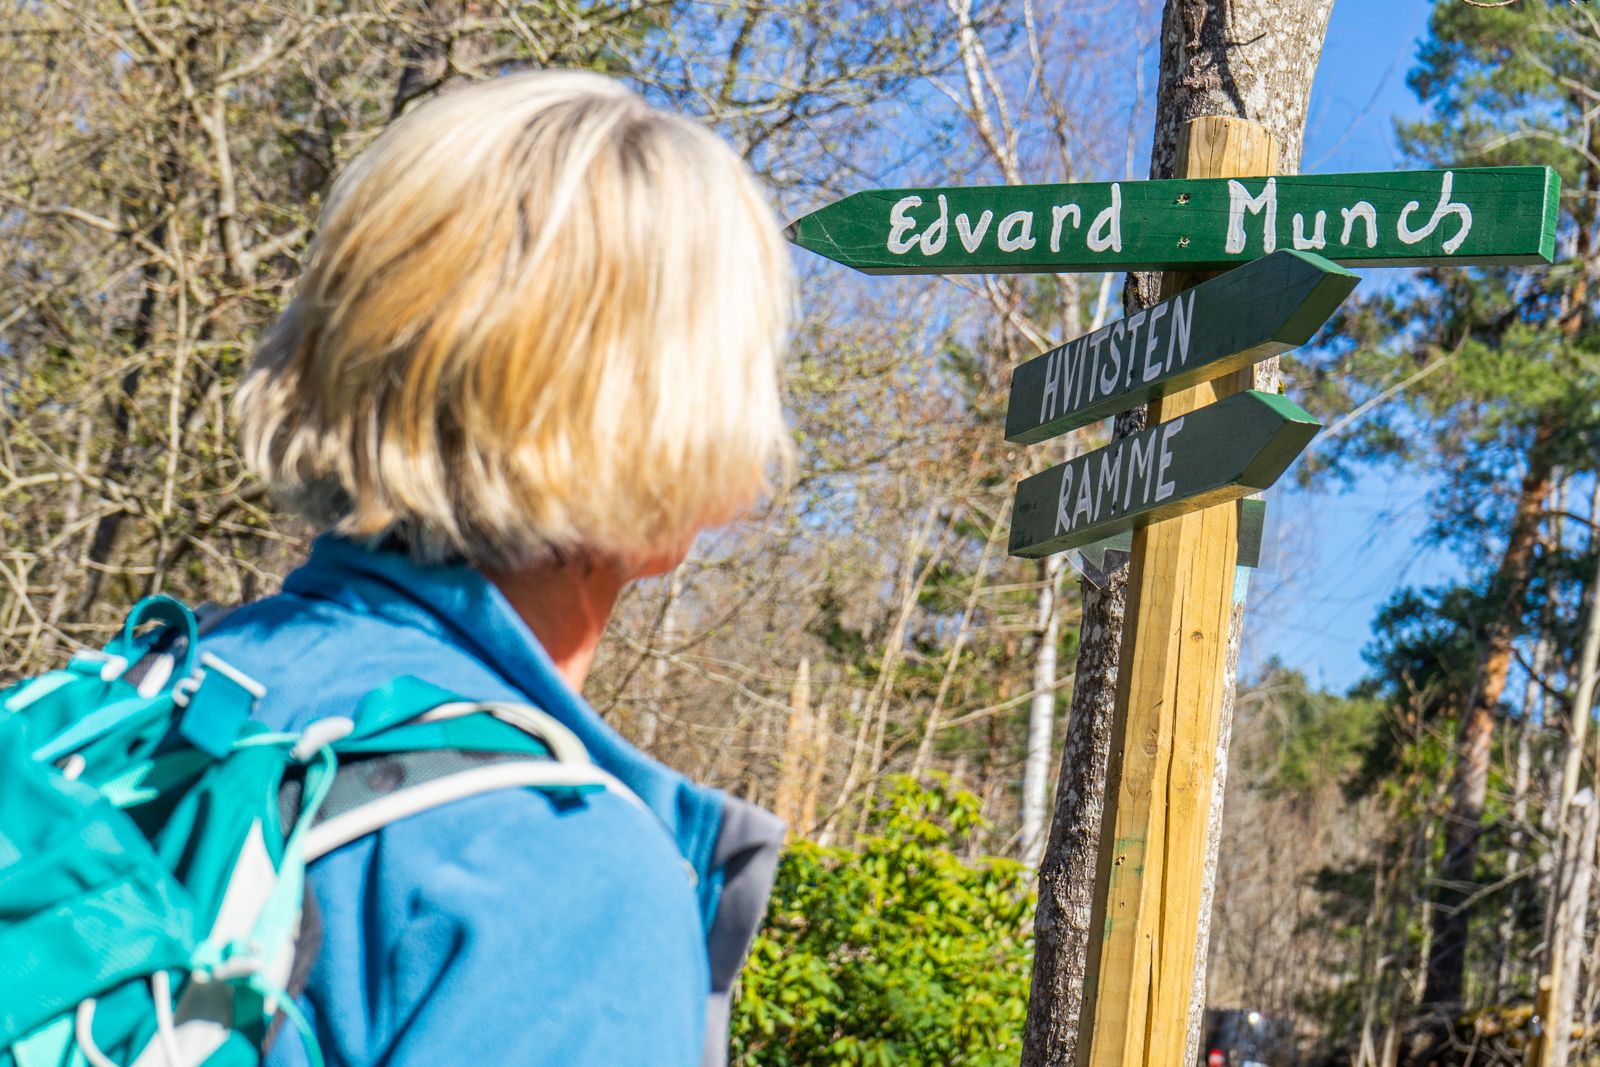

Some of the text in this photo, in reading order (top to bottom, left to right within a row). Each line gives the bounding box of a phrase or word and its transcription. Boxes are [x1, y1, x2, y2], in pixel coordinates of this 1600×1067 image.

[887, 171, 1473, 255] Edvard Munch
[1039, 289, 1196, 424] HVITSTEN
[1053, 416, 1185, 536] RAMME
